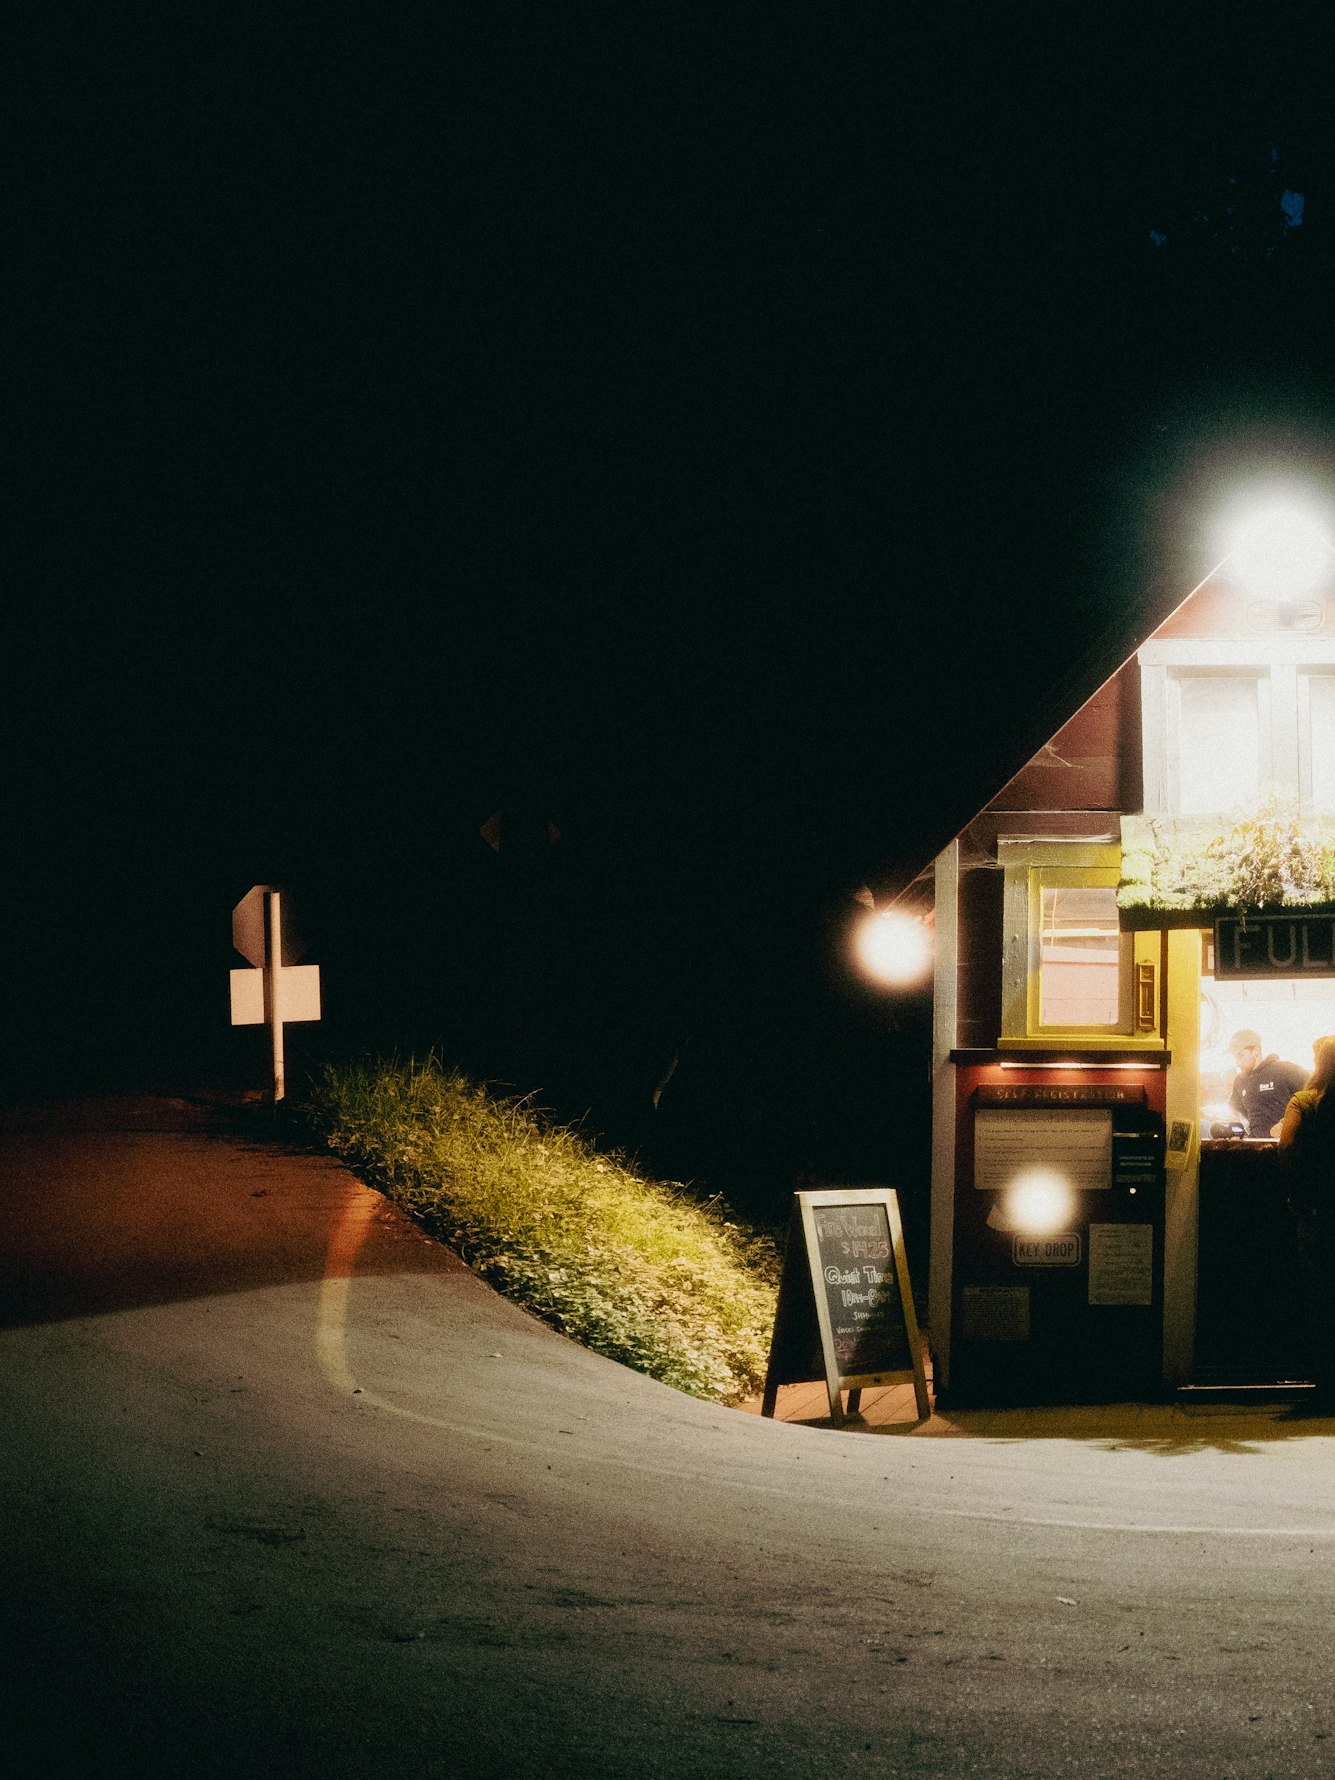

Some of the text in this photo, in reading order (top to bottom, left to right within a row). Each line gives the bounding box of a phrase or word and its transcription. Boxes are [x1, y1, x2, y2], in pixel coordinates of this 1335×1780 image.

[1019, 1242, 1074, 1257] KEY DROP
[824, 1265, 860, 1285] Quiet
